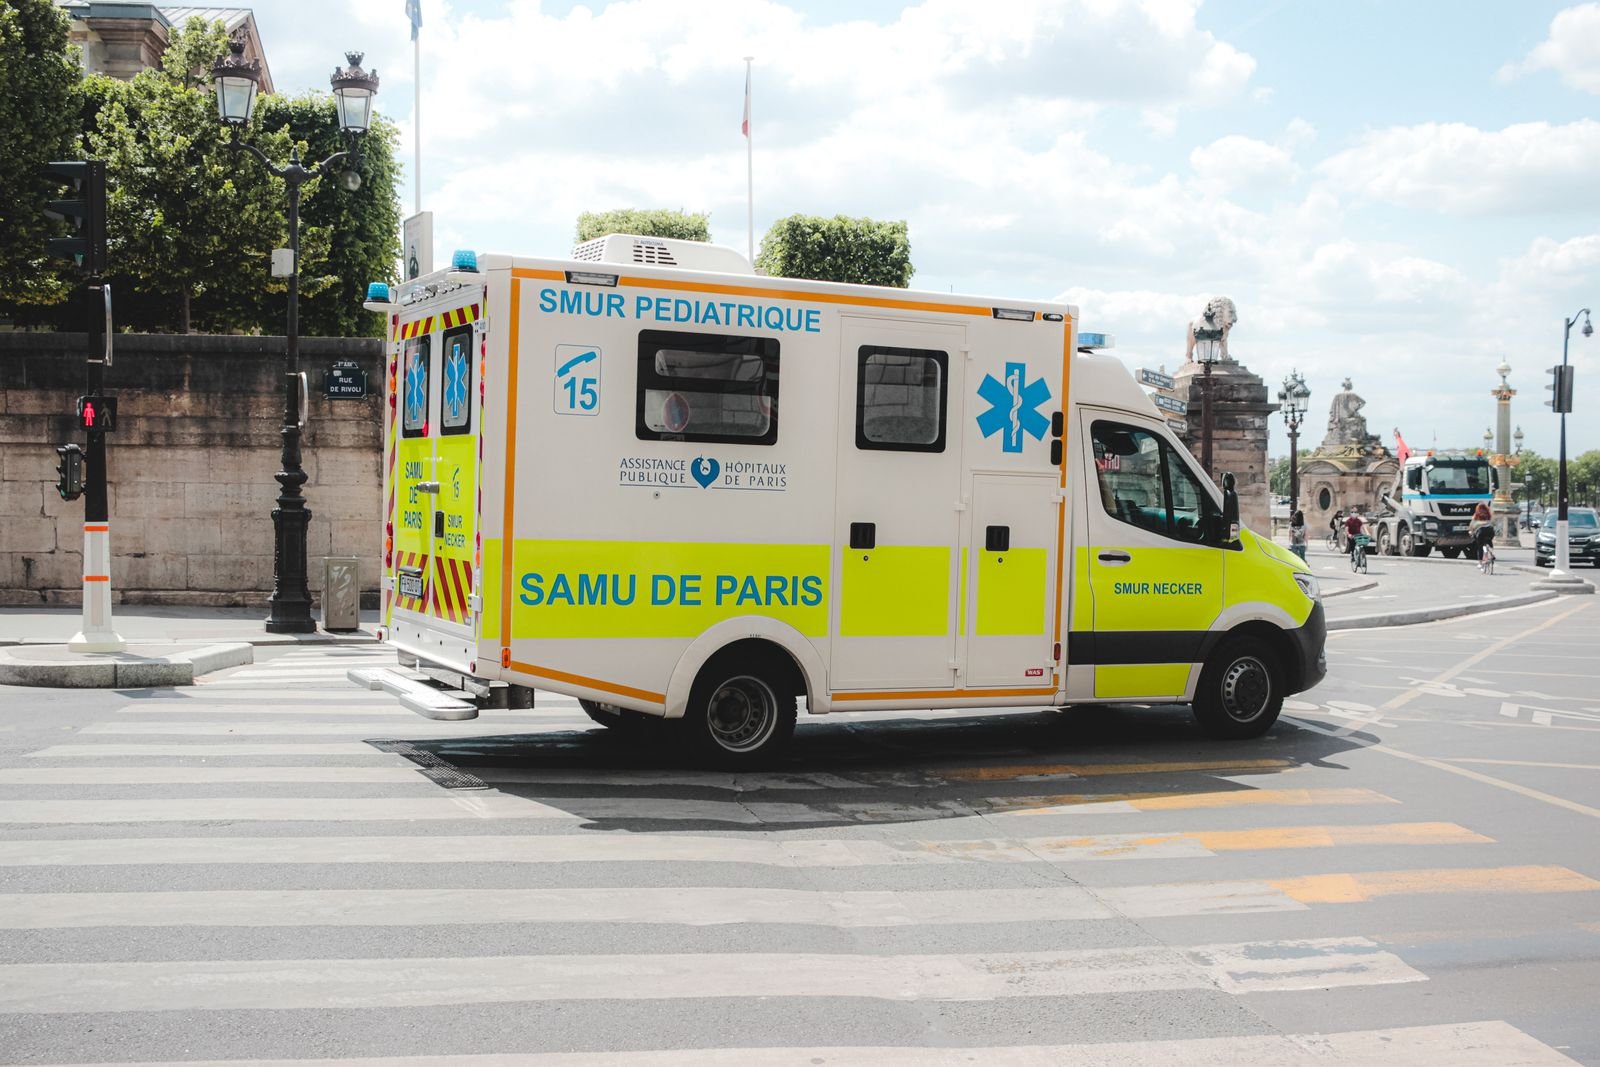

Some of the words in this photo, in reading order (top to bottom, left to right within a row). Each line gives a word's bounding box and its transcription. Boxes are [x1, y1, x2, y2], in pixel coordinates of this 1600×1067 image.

[539, 288, 626, 318] SMUR
[635, 296, 821, 333] PEDIATRIQUE
[563, 376, 598, 410] 15
[406, 462, 423, 479] SAMU
[619, 457, 686, 471] ASSISTANCE
[619, 471, 686, 484] PUBLIQUE
[724, 475, 740, 486] DE
[749, 475, 787, 487] PARIS
[409, 486, 418, 504] DE
[404, 510, 422, 529] PARIS
[448, 514, 462, 529] SMUR
[445, 532, 465, 548] NECKER
[519, 572, 637, 607] SAMU
[650, 574, 702, 606] DE
[715, 575, 823, 607] PARIS
[1114, 582, 1150, 595] SMUR
[1153, 583, 1203, 595] NECKER
